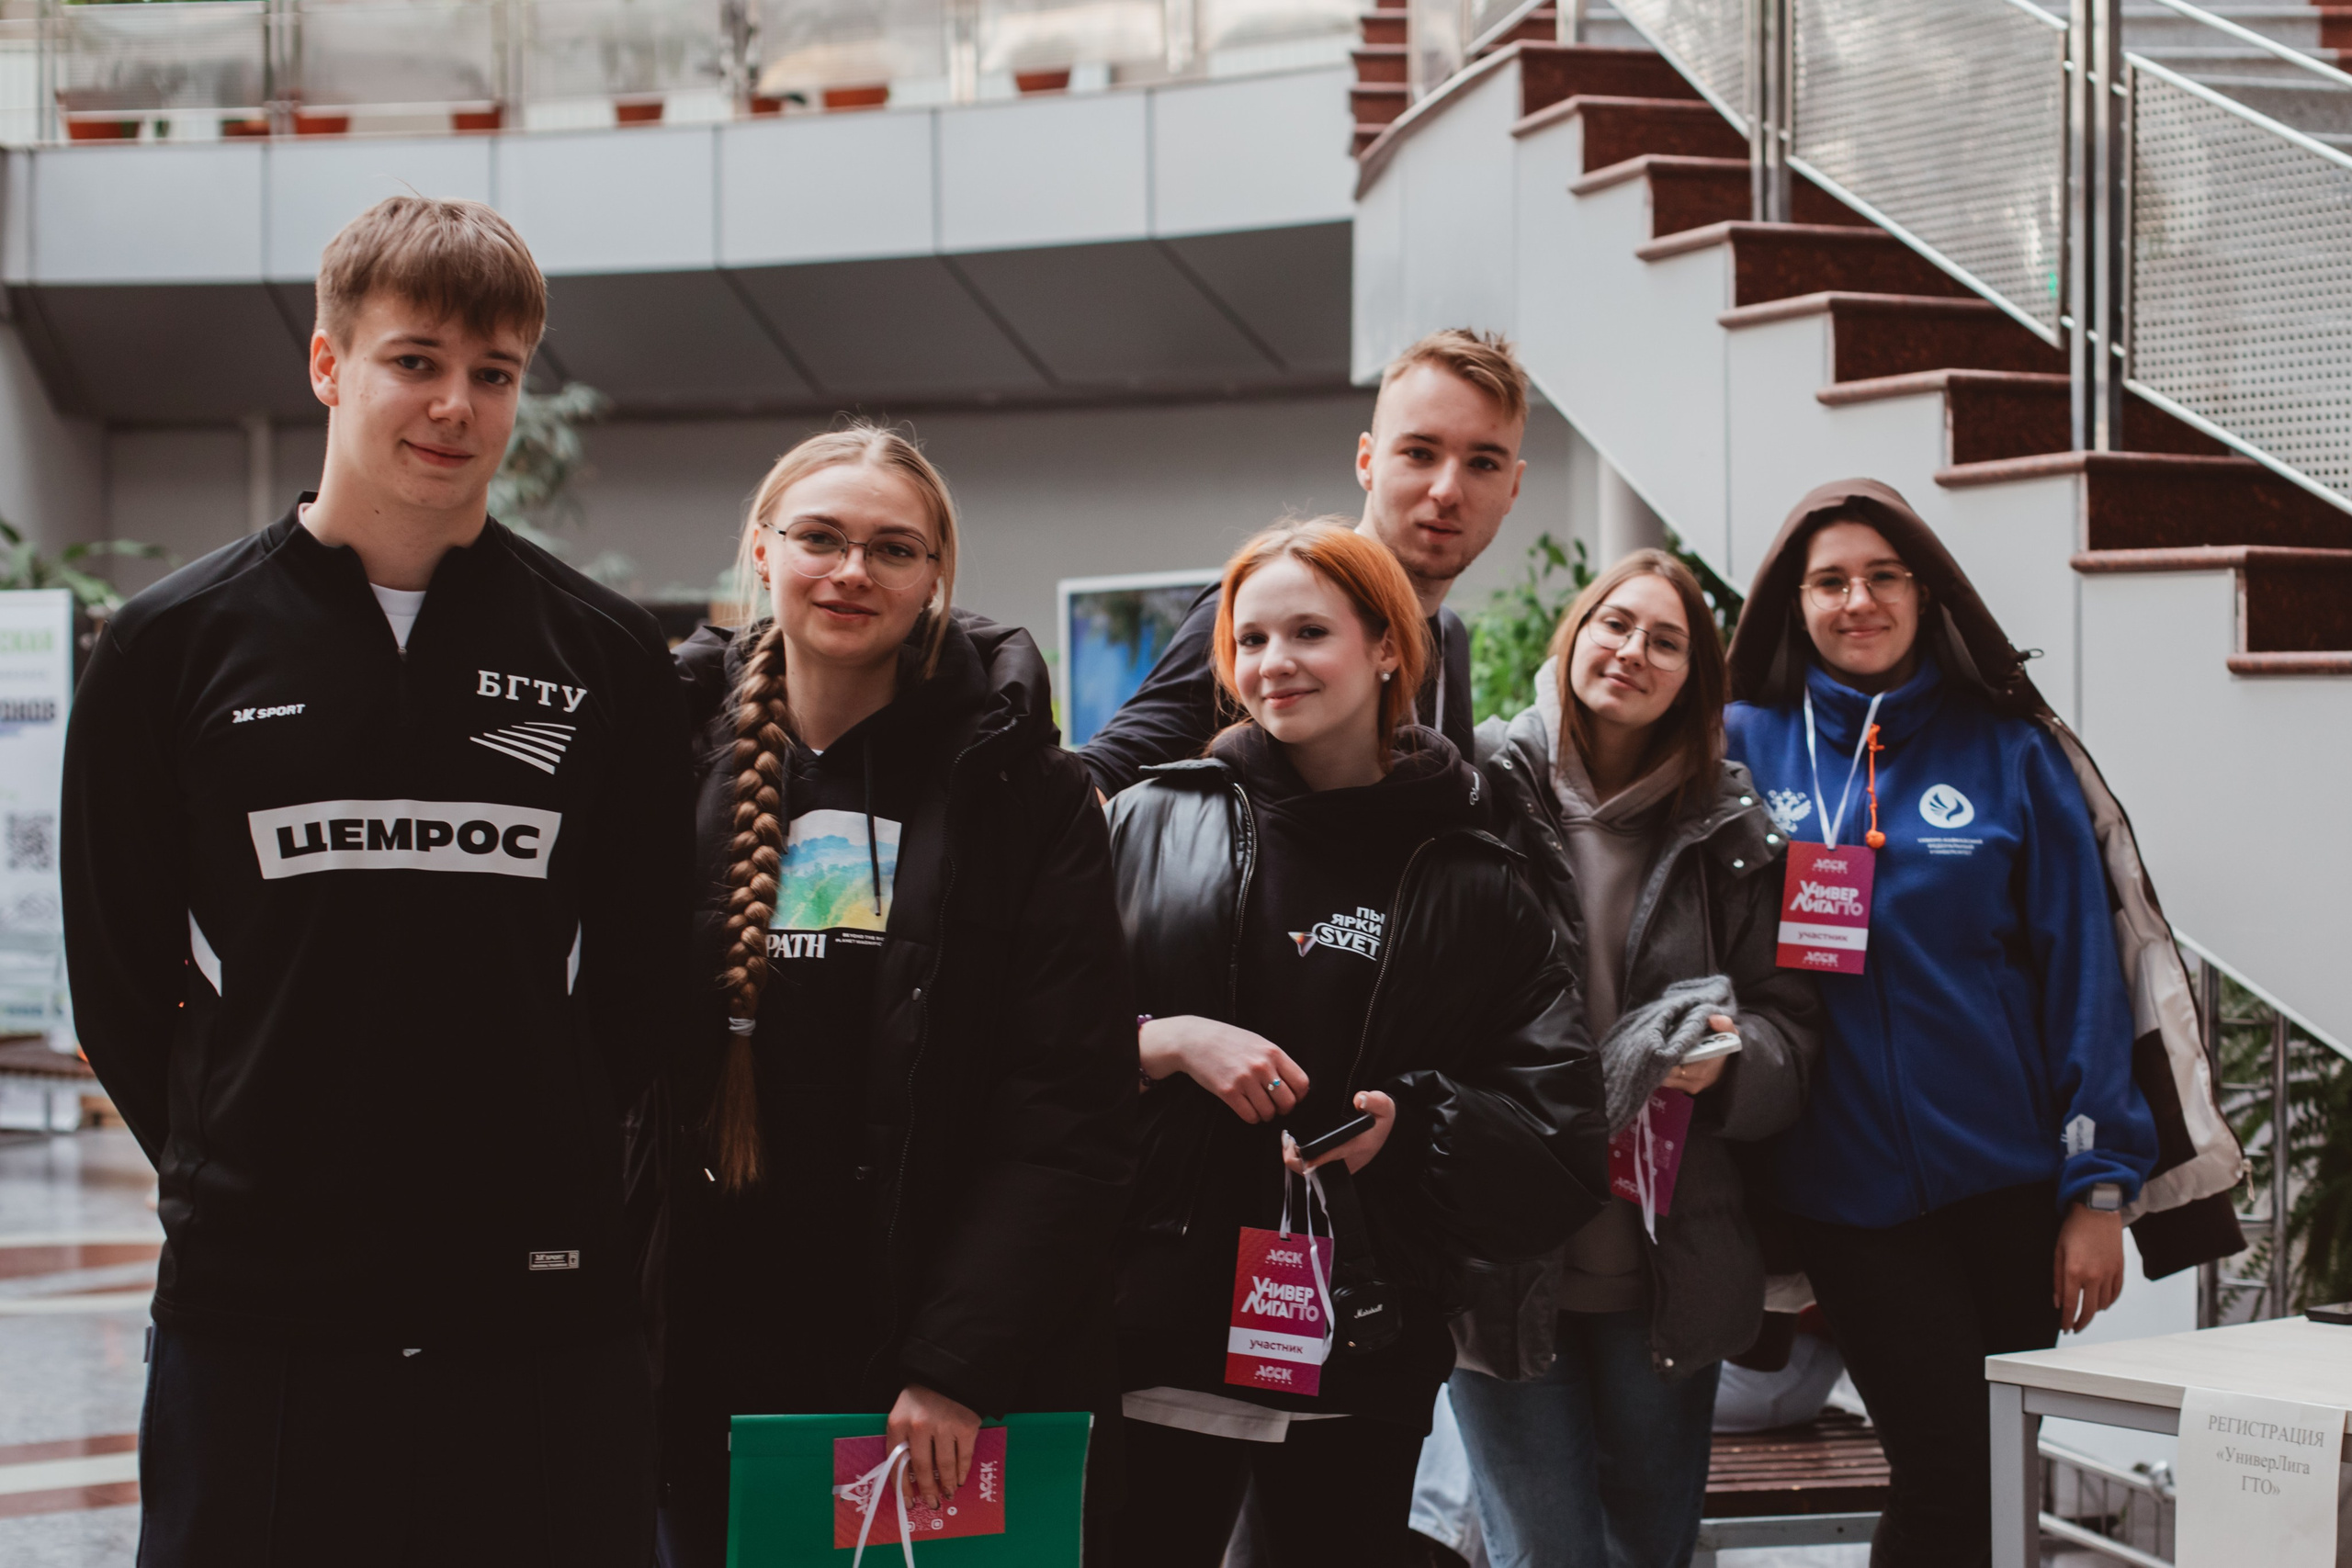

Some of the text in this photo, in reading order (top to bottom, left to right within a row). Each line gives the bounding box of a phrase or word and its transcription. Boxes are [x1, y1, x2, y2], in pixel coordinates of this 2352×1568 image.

[477, 670, 587, 713] БГТУ
[256, 704, 306, 719] SPORT
[277, 818, 540, 860] ЦЕМРОС
[1330, 913, 1382, 936] ЯРКИ
[1356, 907, 1385, 924] ПЫ
[766, 933, 827, 959] PATH
[1319, 927, 1380, 956] SVET
[1252, 1276, 1315, 1306] УНИВЕР
[1250, 1339, 1303, 1354] участник
[2208, 1415, 2325, 1448] РЕГИСТРАЦИЯ
[2216, 1446, 2311, 1474] «УниверЛига
[2242, 1475, 2281, 1496] ГТО»
